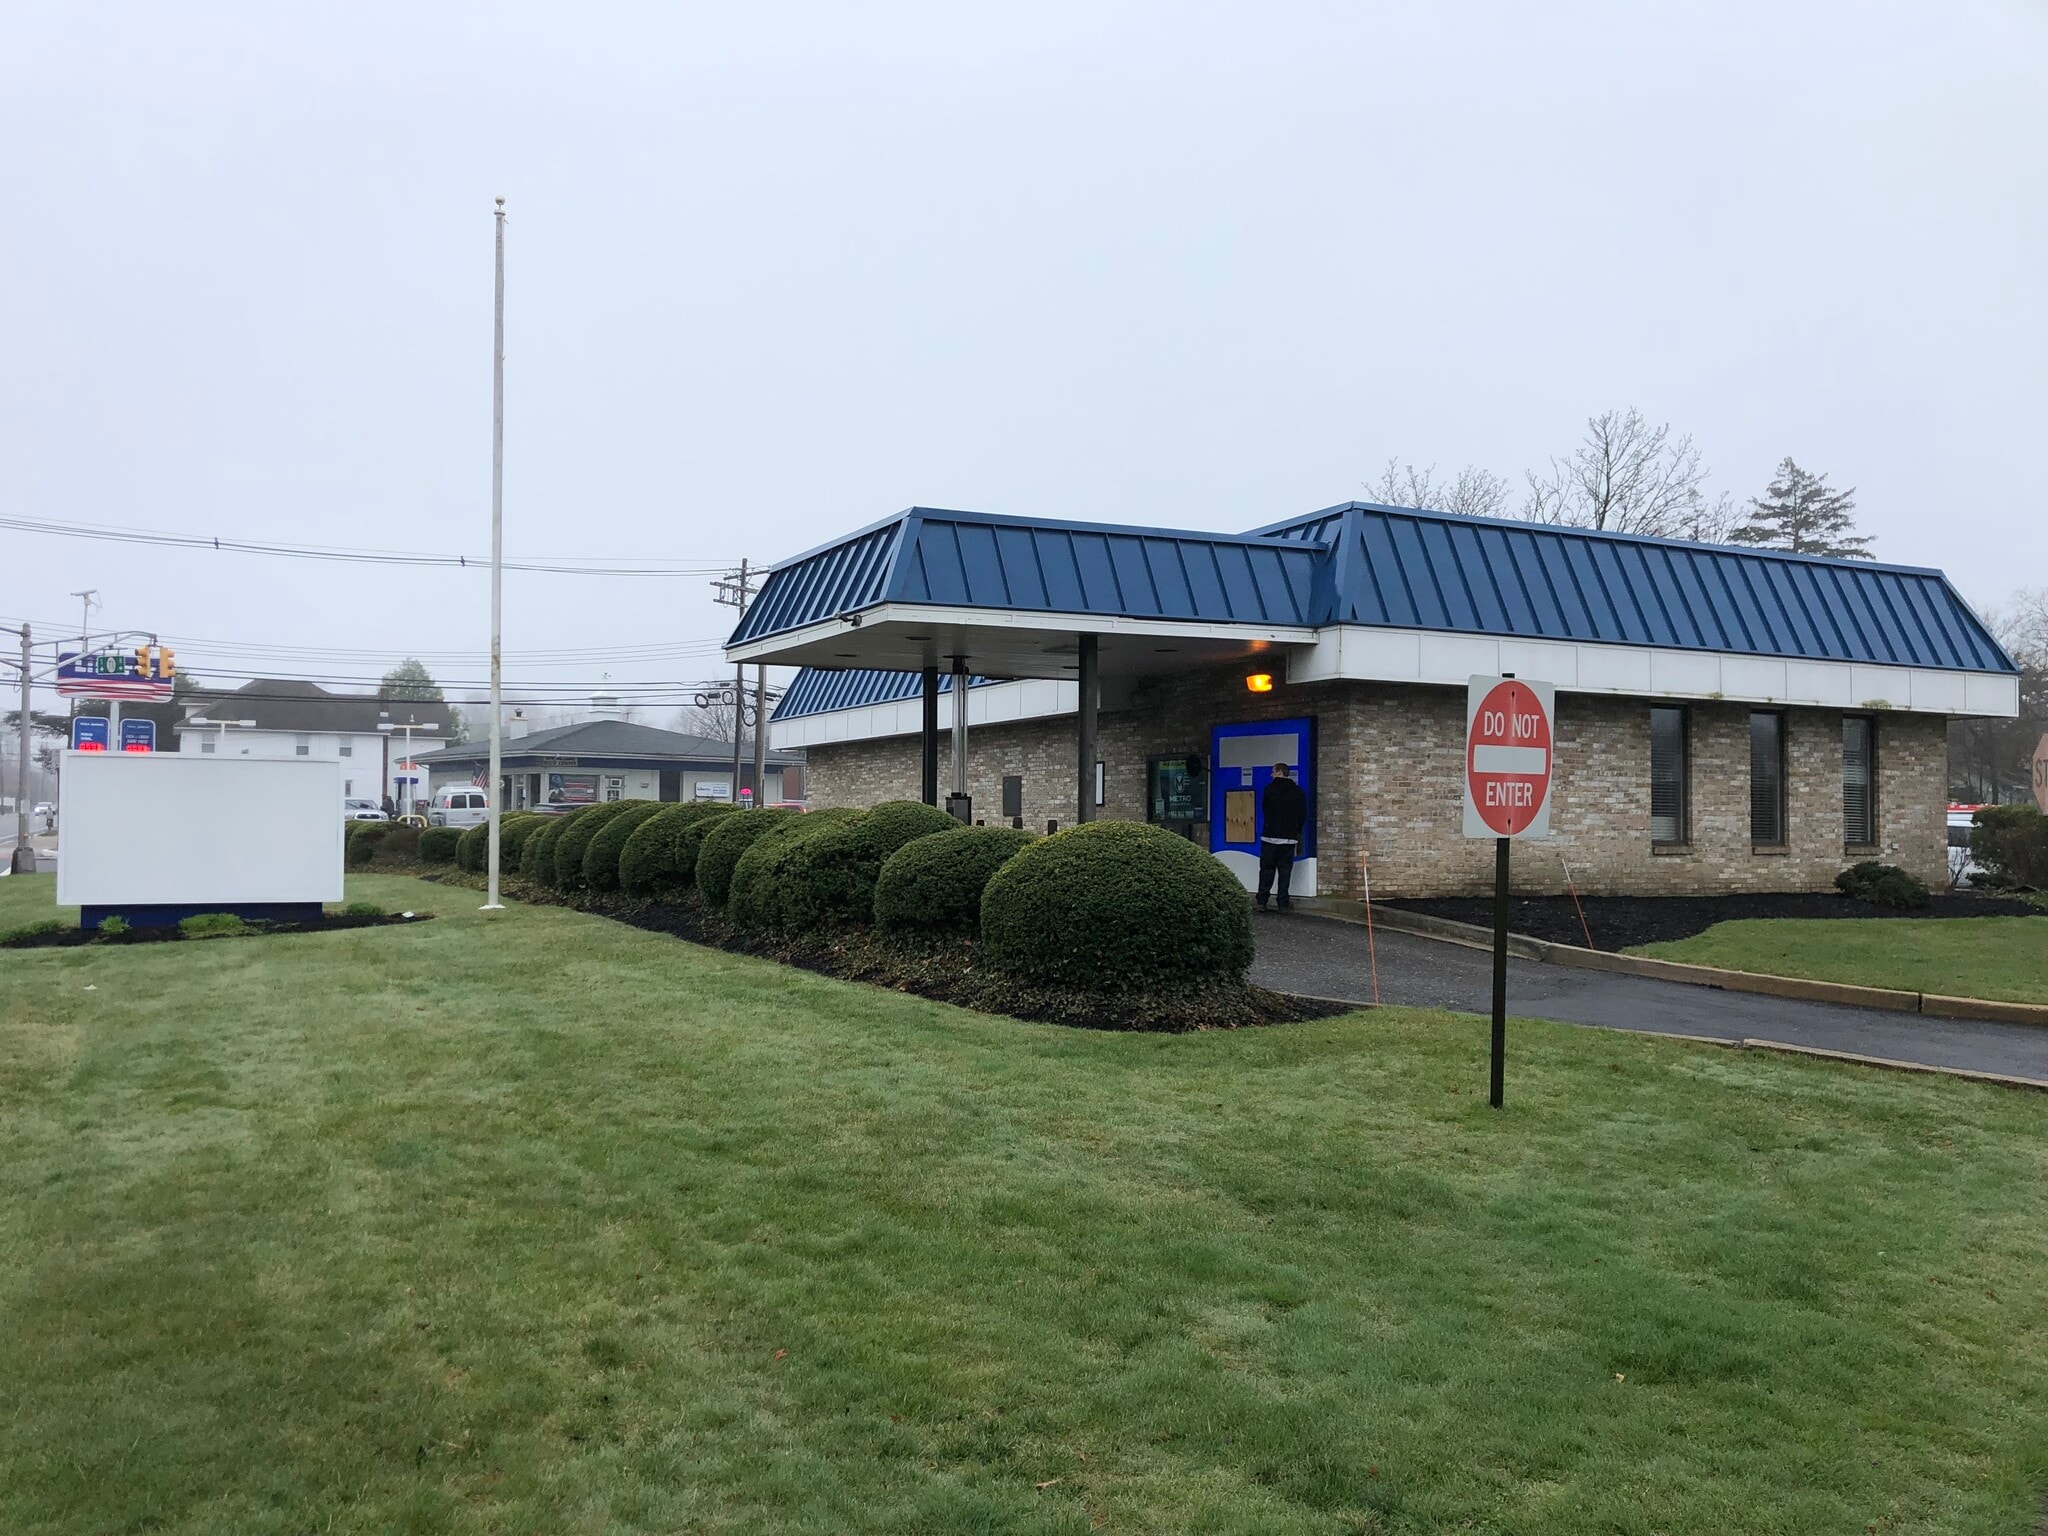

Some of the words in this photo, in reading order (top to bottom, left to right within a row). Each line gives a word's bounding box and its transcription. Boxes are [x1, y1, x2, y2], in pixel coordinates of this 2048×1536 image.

[1484, 711, 1505, 737] DO
[1511, 713, 1540, 739] NOT
[1485, 781, 1533, 807] ENTER
